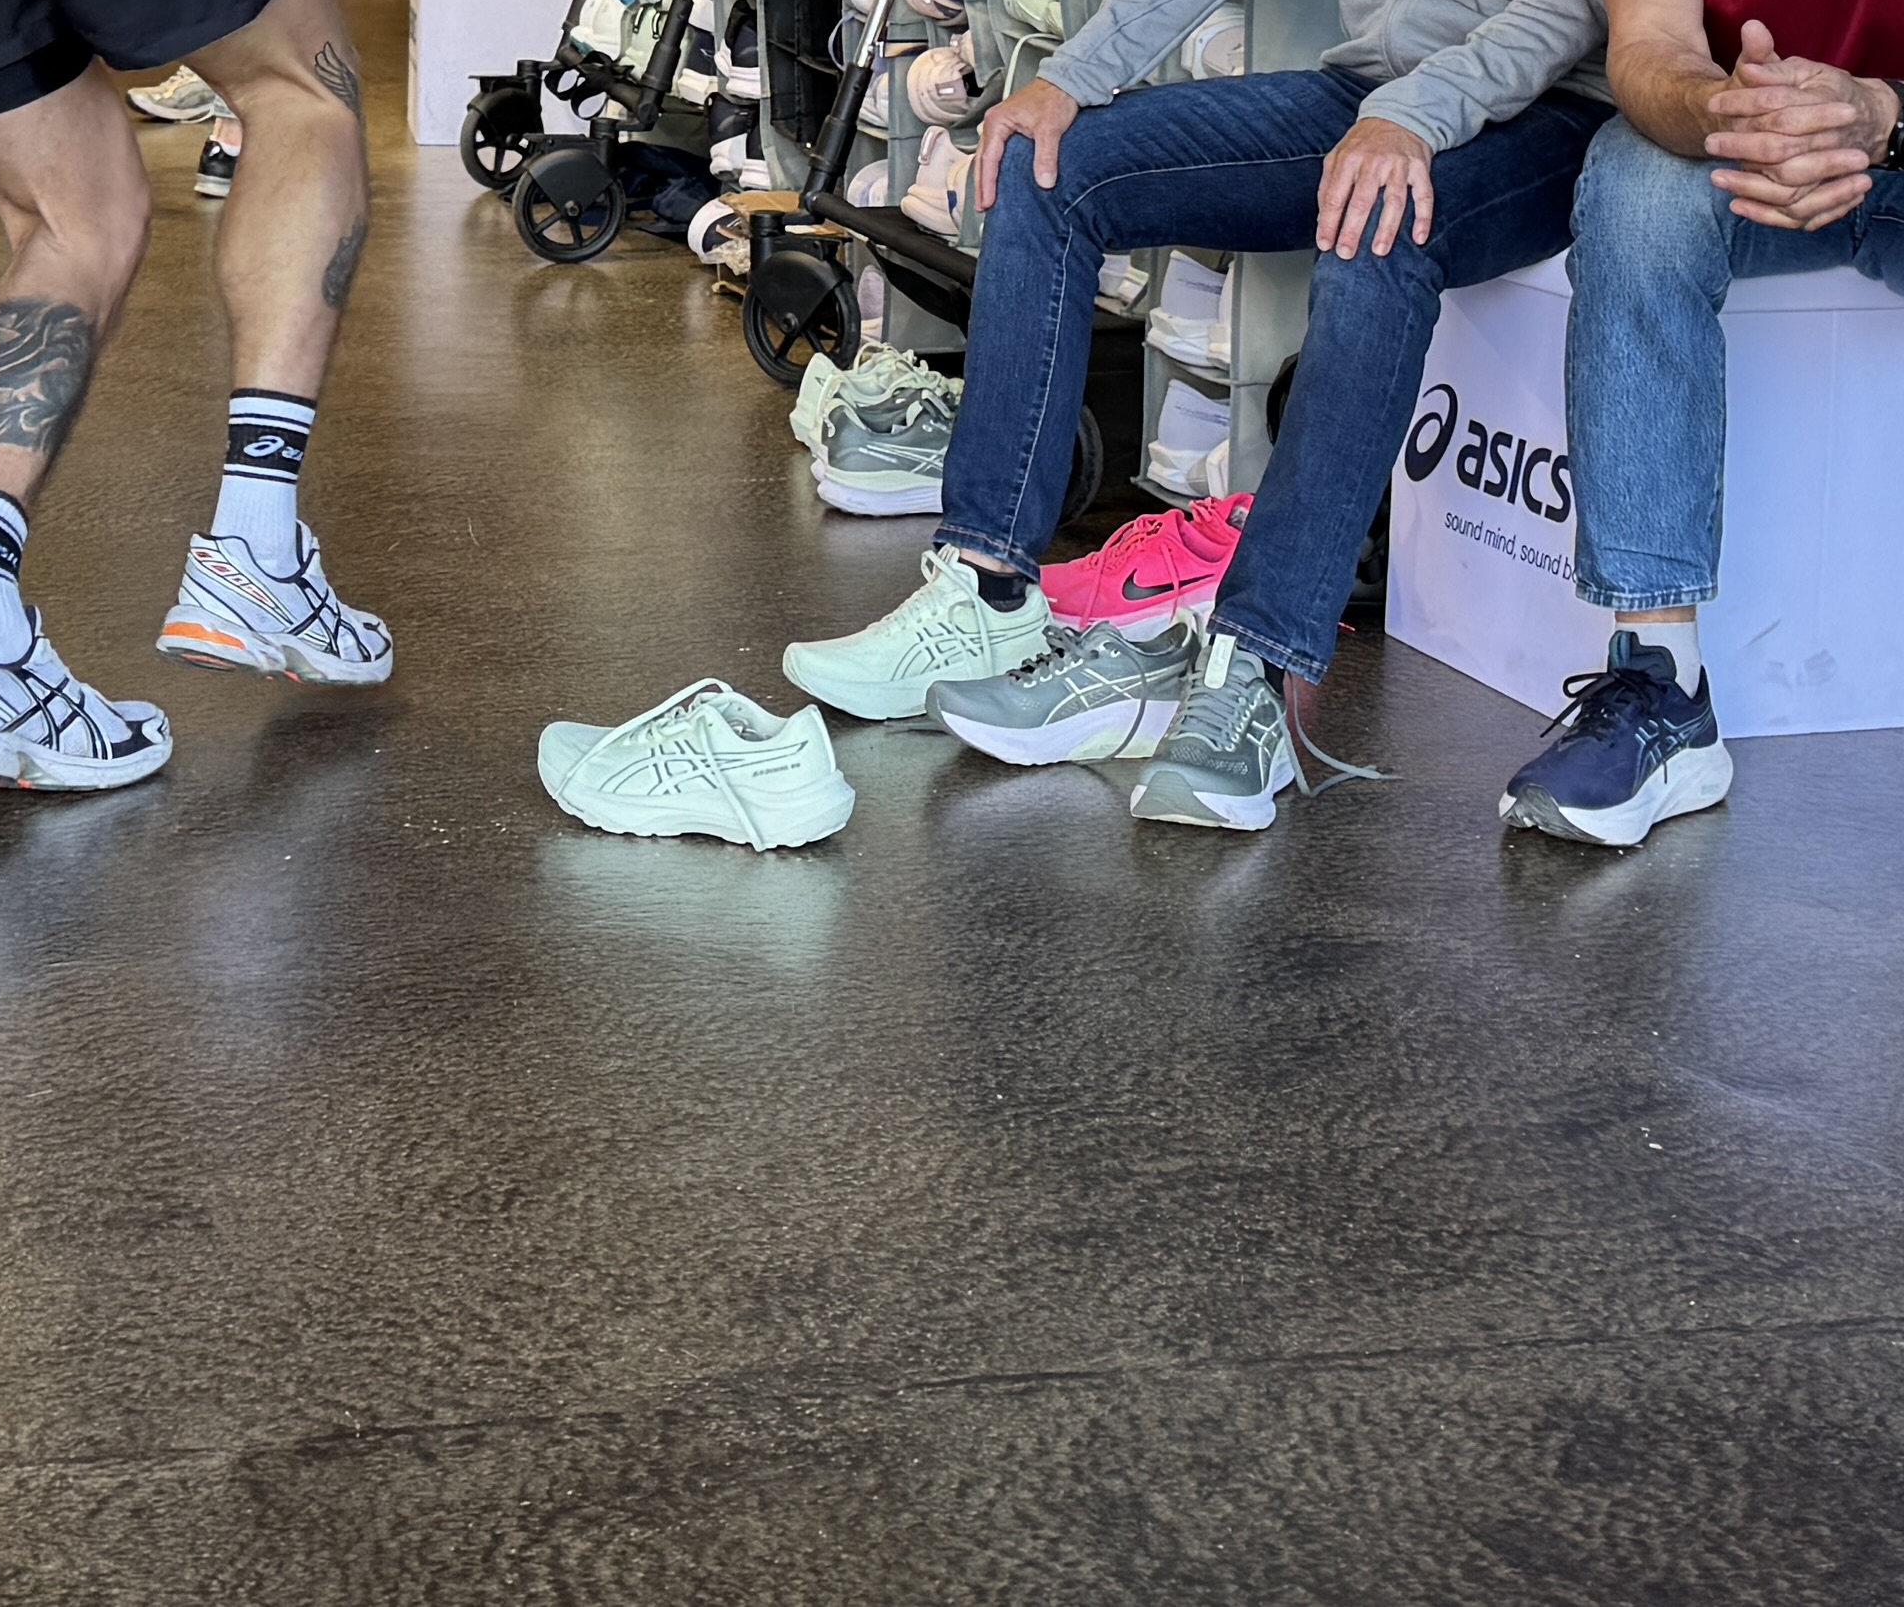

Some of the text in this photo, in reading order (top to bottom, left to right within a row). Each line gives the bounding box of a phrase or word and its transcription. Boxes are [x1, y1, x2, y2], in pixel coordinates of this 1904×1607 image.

[1456, 419, 1572, 523] asics
[1444, 511, 1484, 541] sound
[1484, 528, 1517, 561] mind,
[1520, 544, 1561, 581] sound
